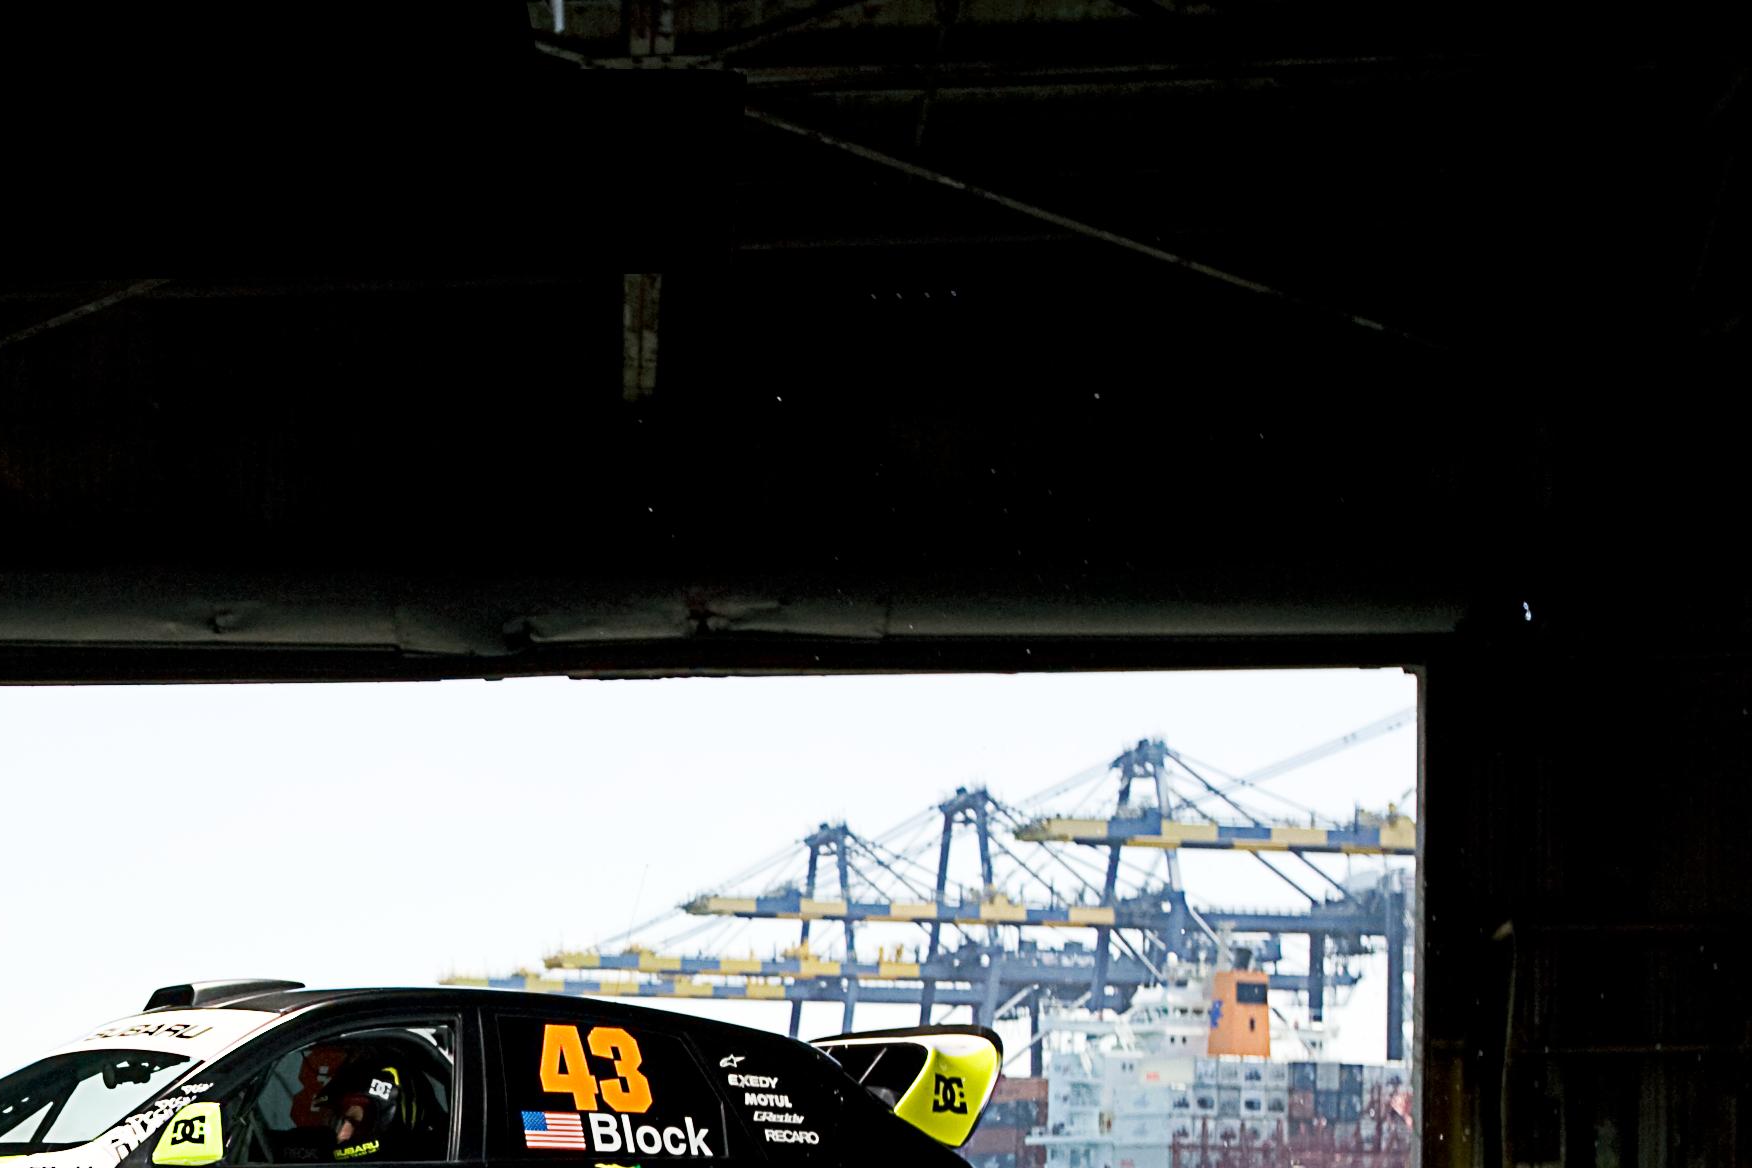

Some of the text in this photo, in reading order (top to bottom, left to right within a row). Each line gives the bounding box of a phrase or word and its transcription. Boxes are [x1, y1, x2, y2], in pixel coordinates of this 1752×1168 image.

[539, 1024, 652, 1112] 43
[728, 1074, 778, 1089] EXEDY
[745, 1092, 792, 1108] MOTUL
[932, 1073, 968, 1114] DC
[171, 1115, 205, 1145] DC
[590, 1113, 713, 1157] Block
[765, 1128, 819, 1145] RECARO
